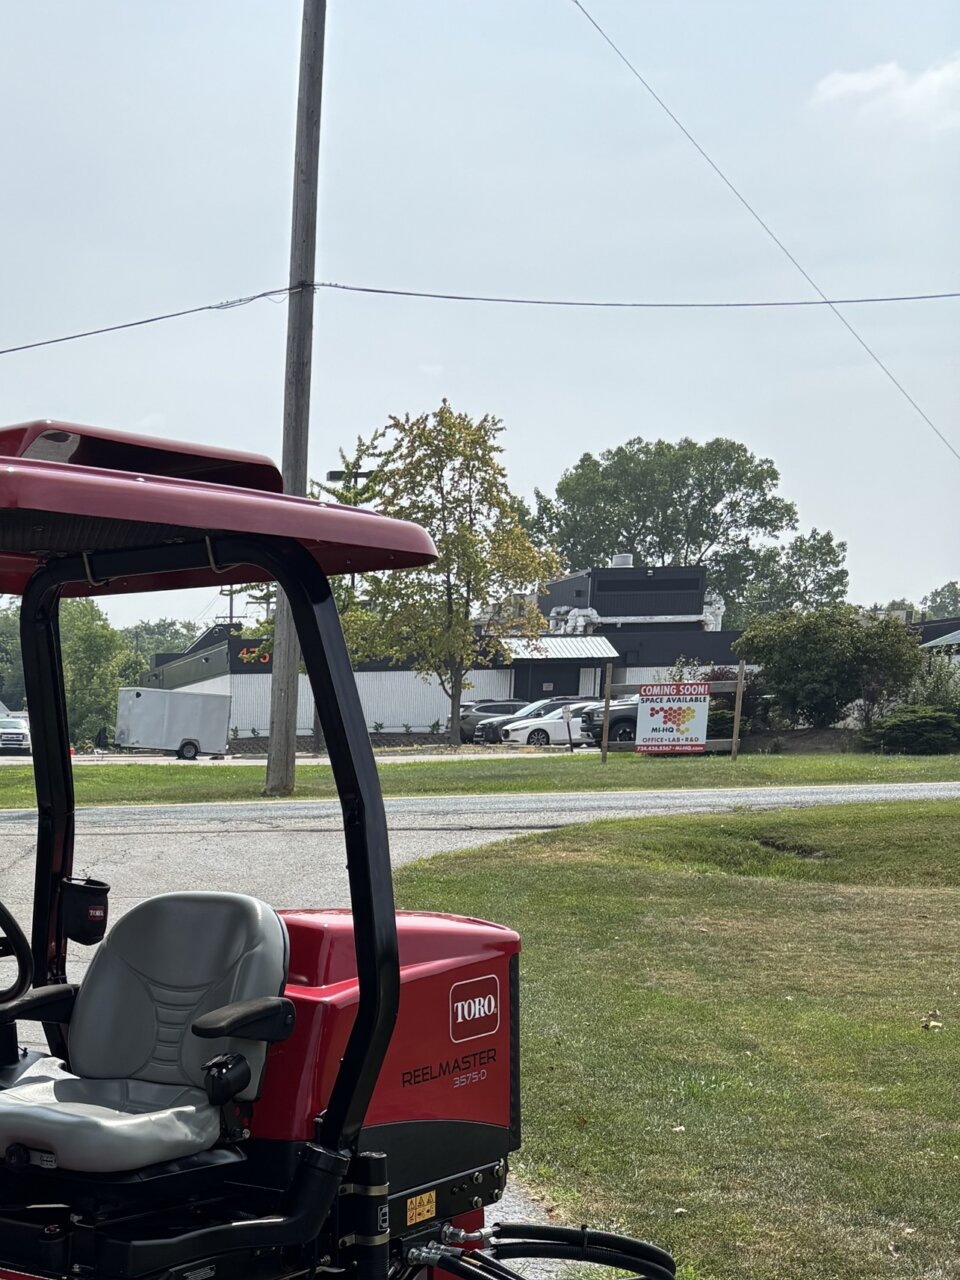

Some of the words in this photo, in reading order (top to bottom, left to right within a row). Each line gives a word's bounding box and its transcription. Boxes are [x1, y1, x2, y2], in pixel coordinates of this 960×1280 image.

[641, 685, 677, 696] COMING
[680, 684, 708, 695] SOON!
[454, 994, 496, 1023] TORO
[402, 1048, 497, 1088] REELMASTER
[453, 1069, 487, 1089] 3575-D
